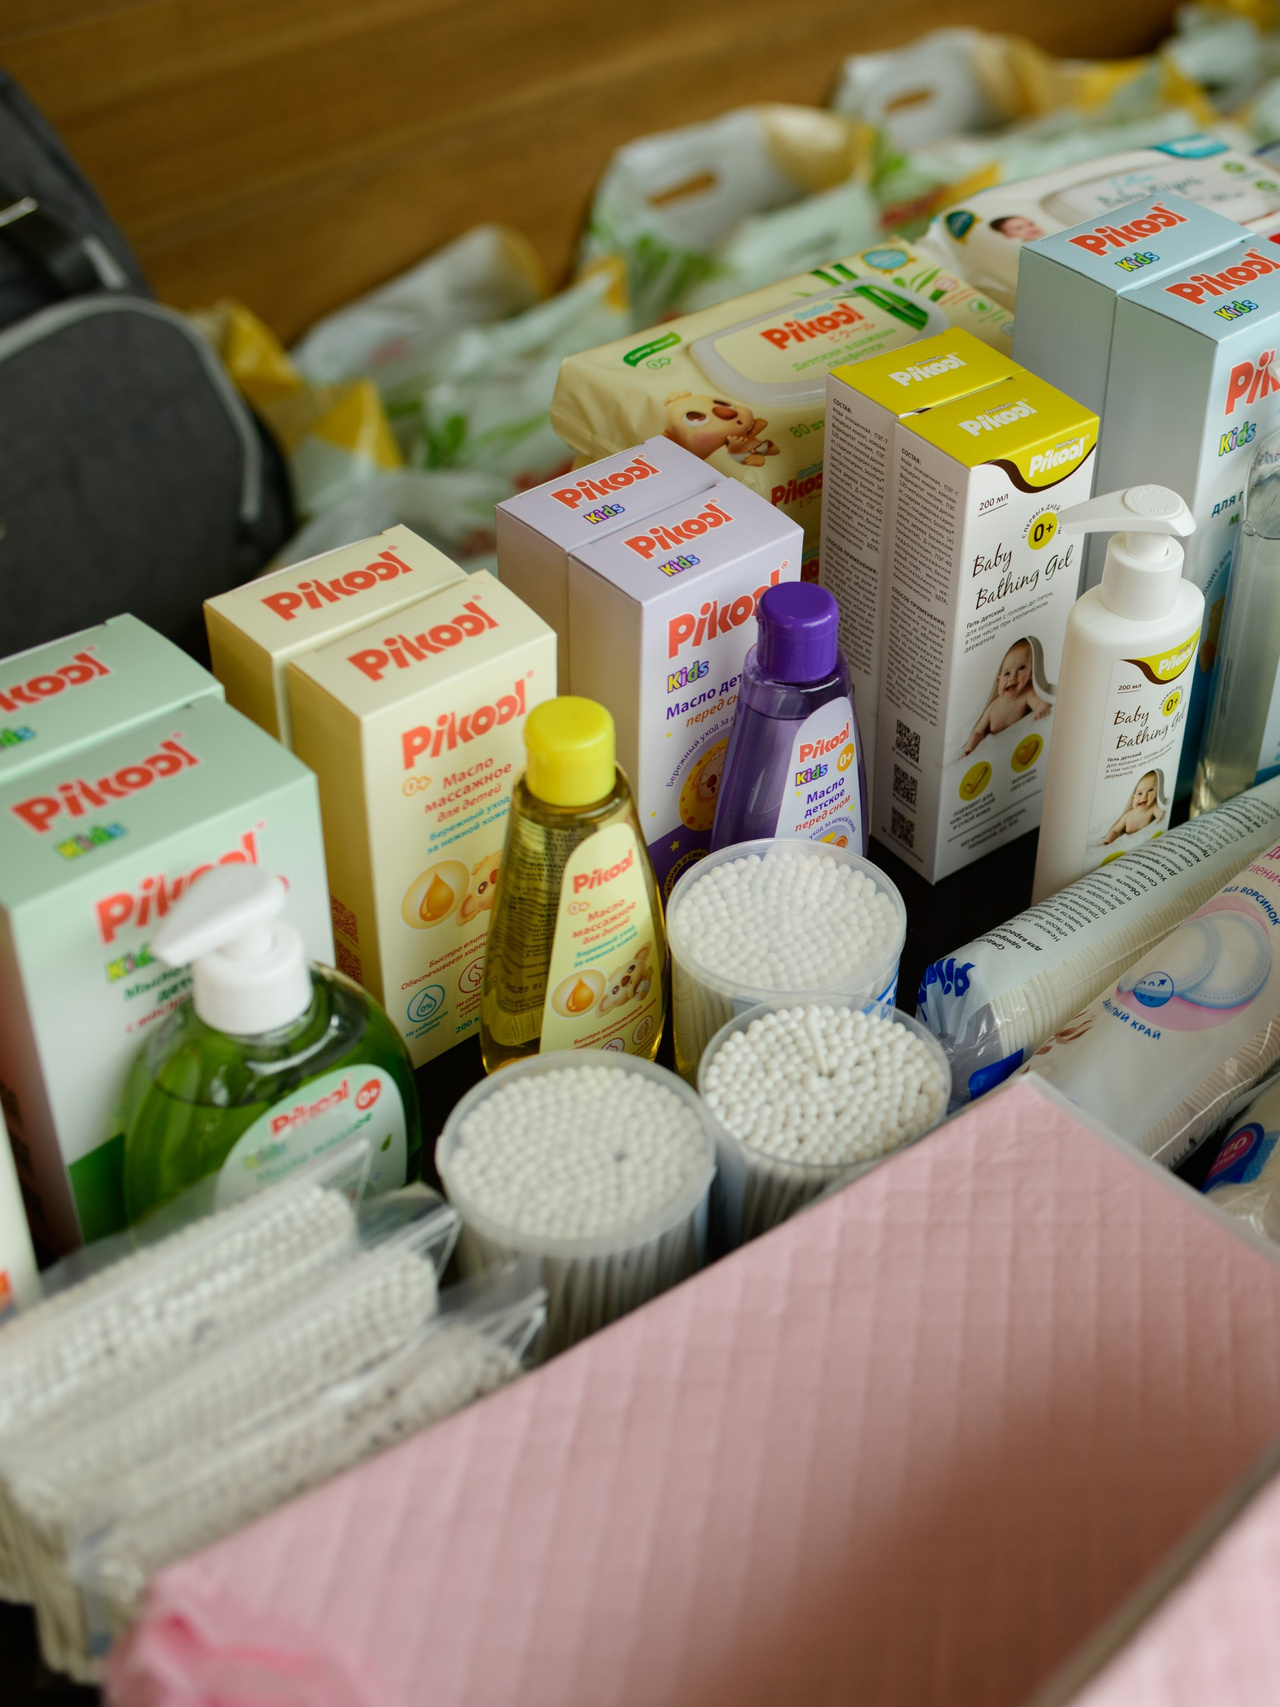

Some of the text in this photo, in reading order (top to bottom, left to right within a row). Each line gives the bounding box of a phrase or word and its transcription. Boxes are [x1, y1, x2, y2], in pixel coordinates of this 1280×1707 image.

[1068, 205, 1190, 257] Pikool
[1115, 251, 1160, 273] Kids
[760, 303, 865, 350] Pikool
[1214, 299, 1259, 321] Kids
[888, 353, 966, 387] Pikool
[958, 400, 1037, 437] Pikool
[1218, 421, 1257, 457] Kids
[1028, 437, 1085, 478] Pikool
[551, 457, 662, 511] Pikool
[583, 501, 626, 526] Kids
[979, 493, 1009, 511] 200 мл
[1211, 494, 1236, 518] для
[624, 502, 734, 560] Pikool
[1033, 523, 1054, 543] 0+
[658, 552, 701, 578] Kids
[972, 543, 1013, 578] Baby
[975, 544, 1075, 610] Bathing Gel
[261, 551, 413, 621] Pikool
[965, 626, 977, 638] для
[977, 614, 1002, 632] купания
[1006, 603, 1028, 618] головы
[1028, 599, 1036, 607] до
[966, 605, 1005, 629] Гель детский
[969, 632, 982, 643] том
[982, 624, 1000, 637] числе
[1000, 618, 1012, 631] при
[1012, 600, 1050, 623] атопическом
[347, 601, 499, 682] Pikool
[963, 633, 996, 655] дерматите
[0, 652, 111, 713] kool
[667, 659, 710, 694] Kids
[666, 685, 716, 720] Масло
[686, 698, 723, 728] перед
[1114, 706, 1149, 727] Baby
[1166, 698, 1178, 711] 0+
[402, 678, 526, 770] Pikool
[800, 721, 849, 762] Pikool
[1116, 724, 1169, 750] Bathing
[666, 717, 730, 788] Бережный уход за
[839, 752, 853, 767] 0+
[11, 739, 200, 834] Pikool
[425, 763, 512, 814] массажное
[443, 757, 494, 789] Масло
[795, 764, 828, 787] Kids
[806, 777, 845, 804] Масло
[429, 796, 510, 841] Бережный уход
[437, 784, 502, 823] для детей
[795, 795, 851, 832] перед сном
[804, 788, 845, 819] детское
[426, 823, 480, 855] за нежной
[573, 849, 633, 894] Pikool
[573, 902, 636, 938] массажное
[587, 899, 625, 922] Масло
[1240, 886, 1280, 927] ВОРСИНОК
[401, 955, 463, 990] Обеспечивает
[429, 946, 462, 968] Быстро
[420, 1002, 433, 1013] 0%
[456, 1021, 472, 1034] 200
[1131, 1020, 1162, 1040] КРАЙ
